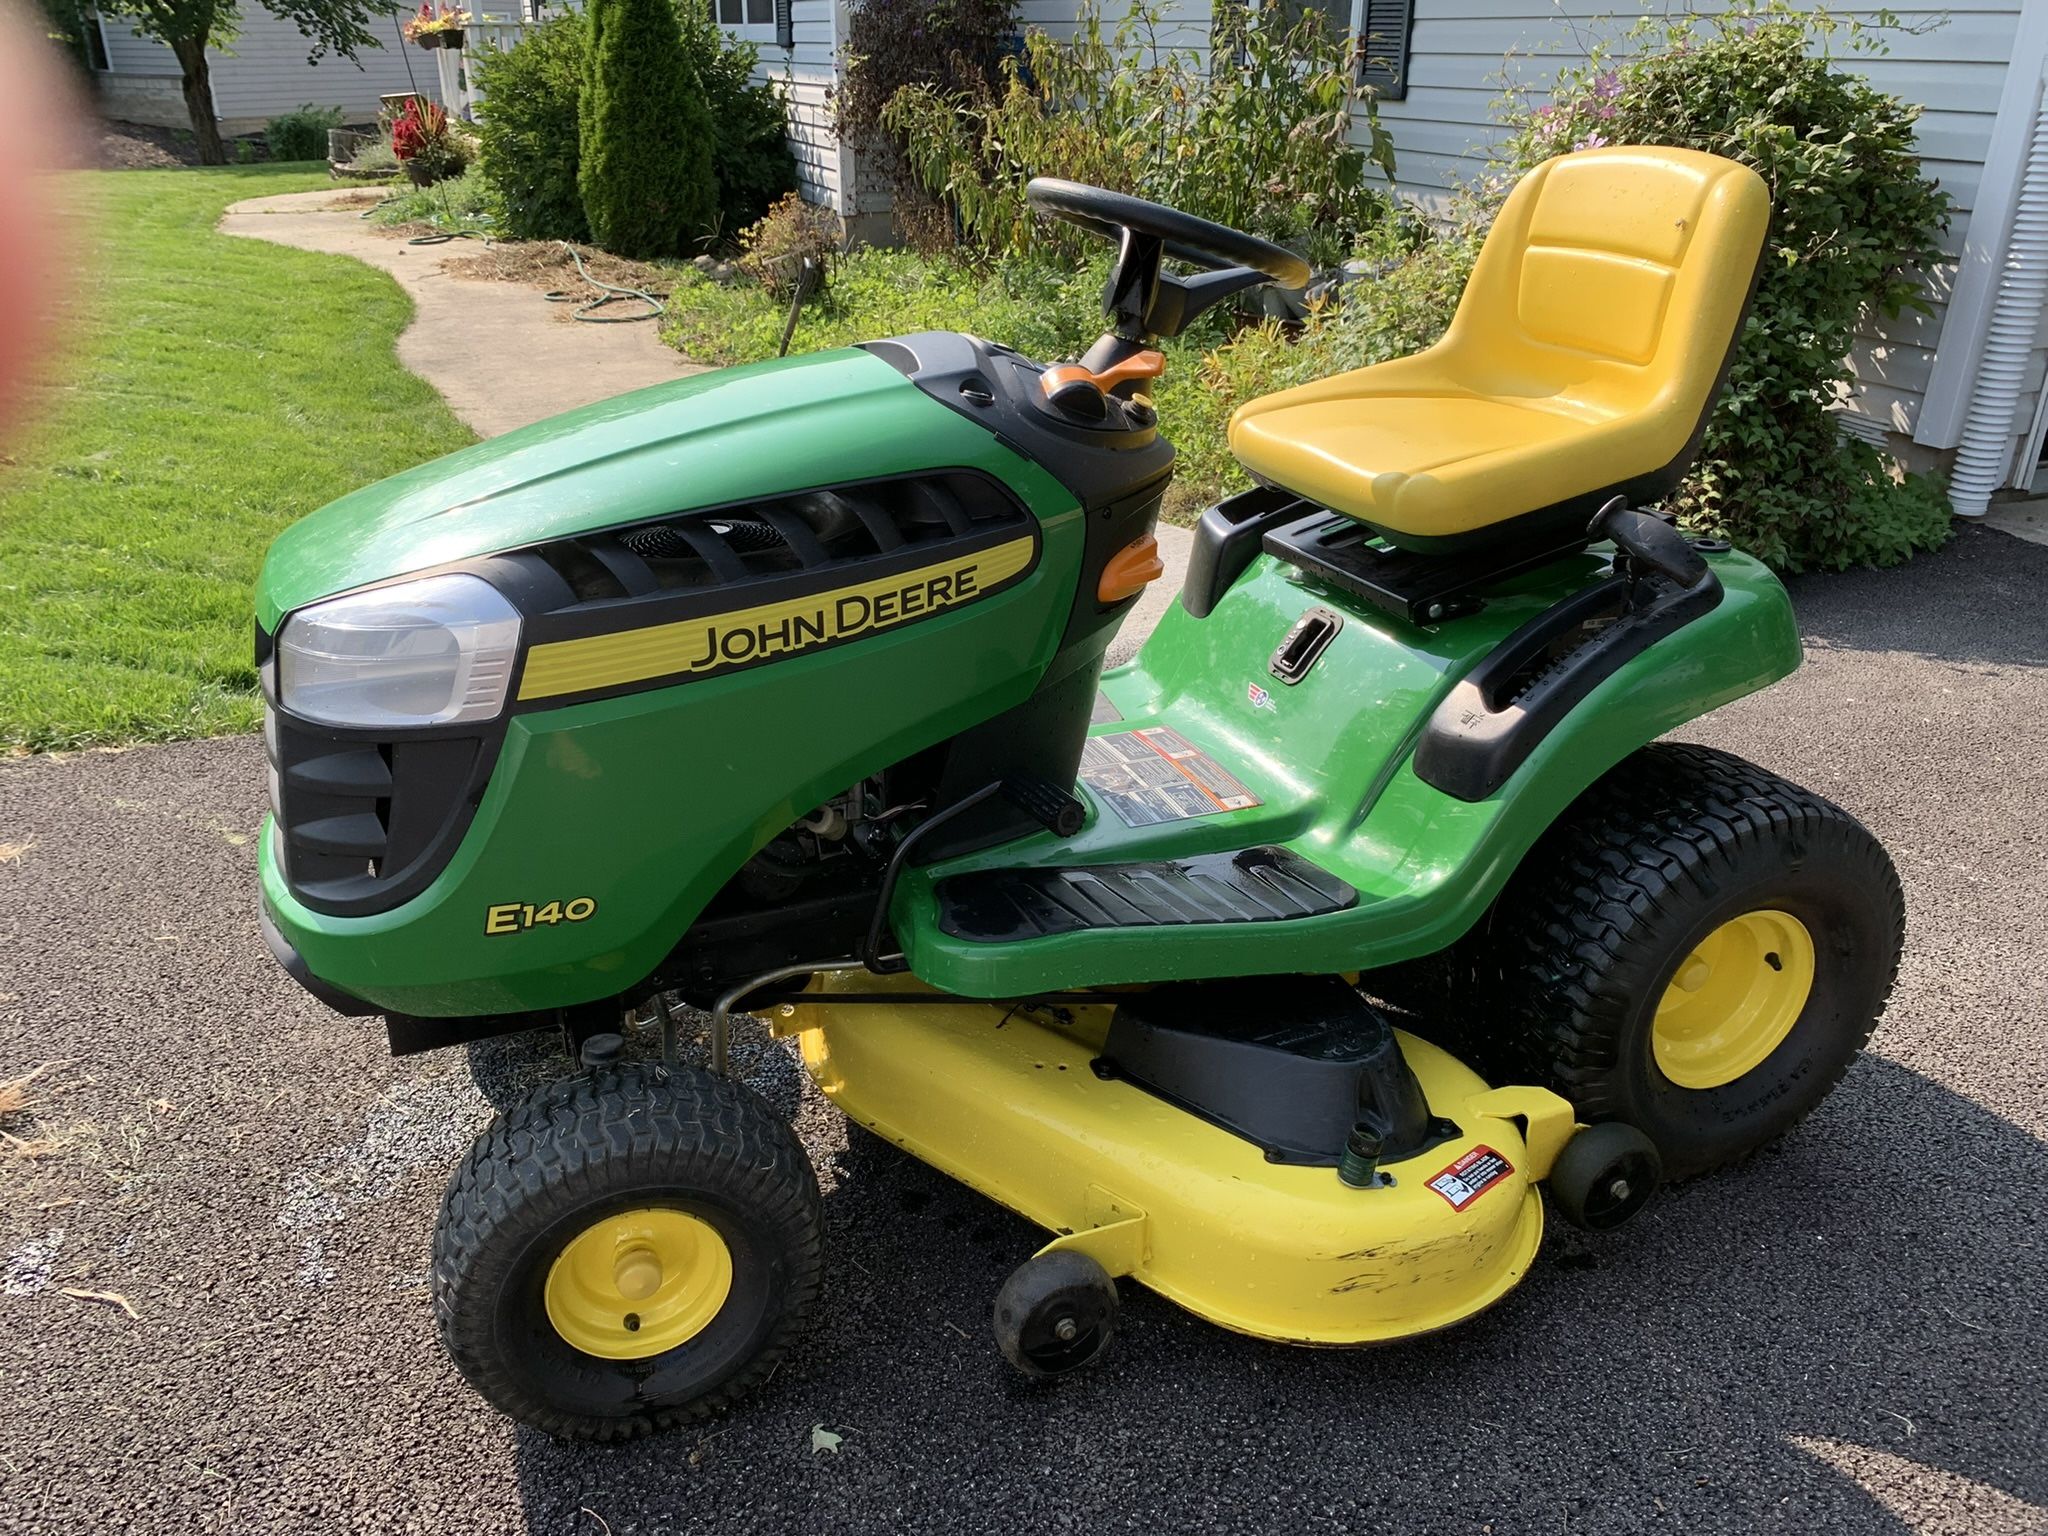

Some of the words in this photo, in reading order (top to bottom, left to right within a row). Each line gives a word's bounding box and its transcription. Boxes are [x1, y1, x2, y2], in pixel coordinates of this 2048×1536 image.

[691, 610, 824, 668] JOHN
[836, 565, 978, 634] DEERE
[485, 897, 596, 935] E140
